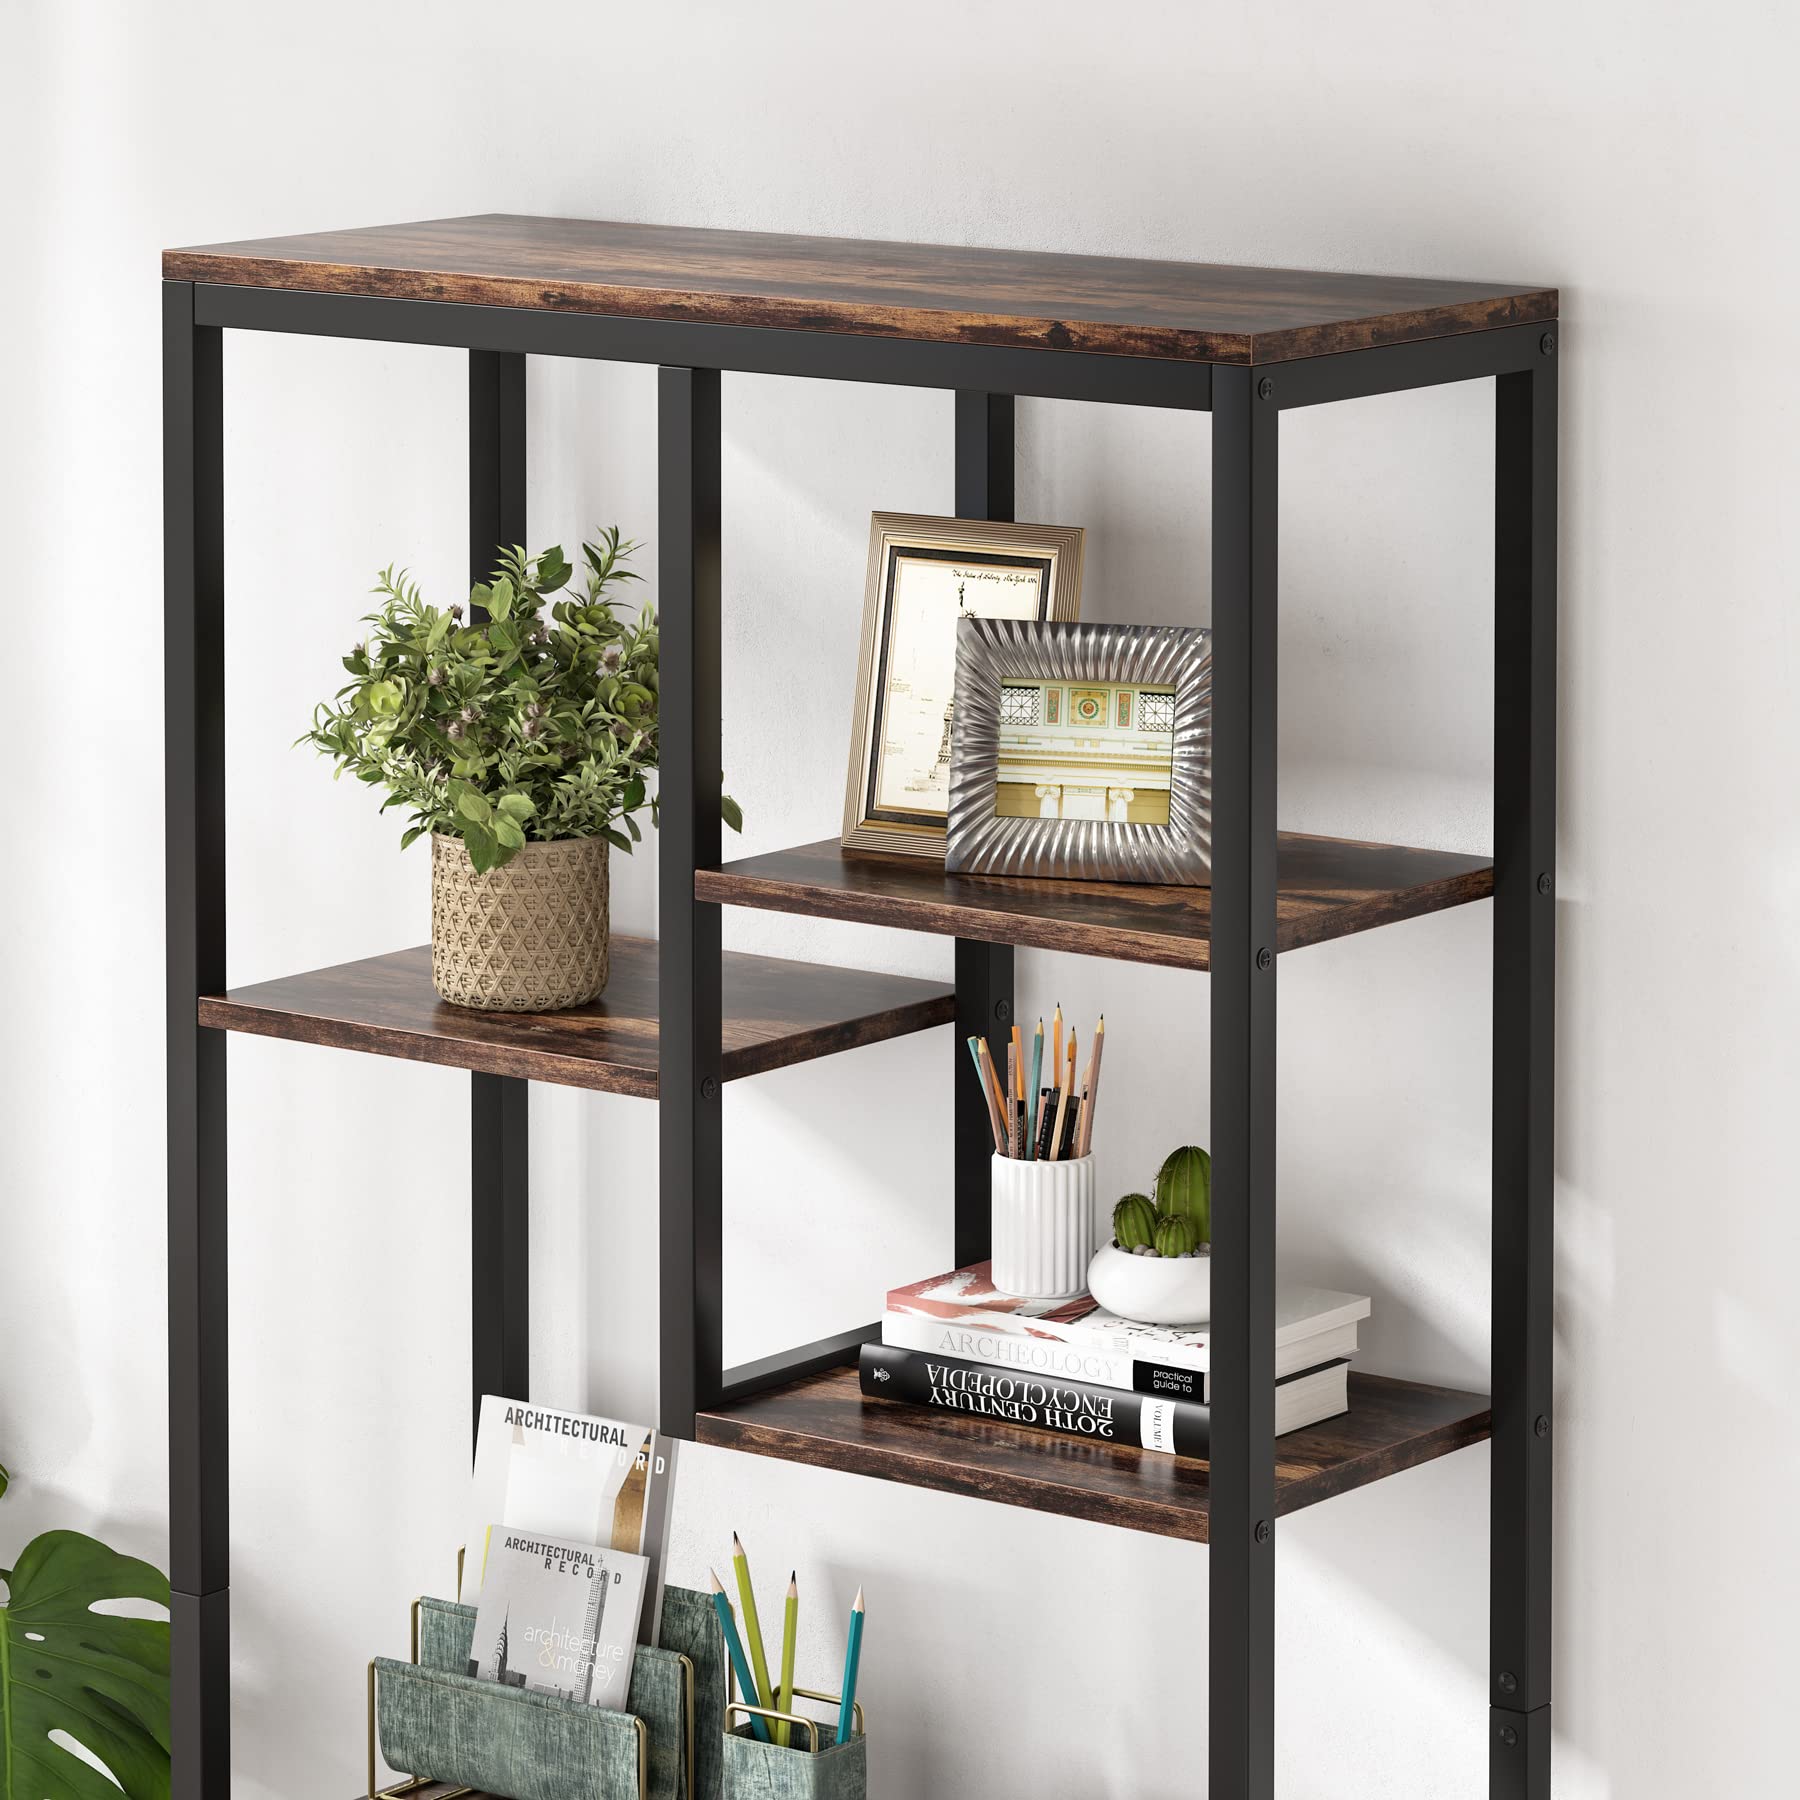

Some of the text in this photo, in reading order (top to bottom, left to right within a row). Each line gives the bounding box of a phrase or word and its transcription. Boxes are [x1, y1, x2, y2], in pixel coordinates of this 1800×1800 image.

[939, 1330, 1118, 1381] ARCHEOLOGY
[925, 1362, 1115, 1420] ENCYCLOPEDIA
[1153, 1370, 1193, 1384] practical
[1153, 1379, 1193, 1393] guide to
[928, 1386, 1037, 1423] CENTURY
[504, 1406, 628, 1448] ARCHITECTURAL
[1153, 1404, 1164, 1444] VOLUME
[504, 1536, 595, 1566] ARCHITECTURAL
[544, 1557, 622, 1585] RECORD
